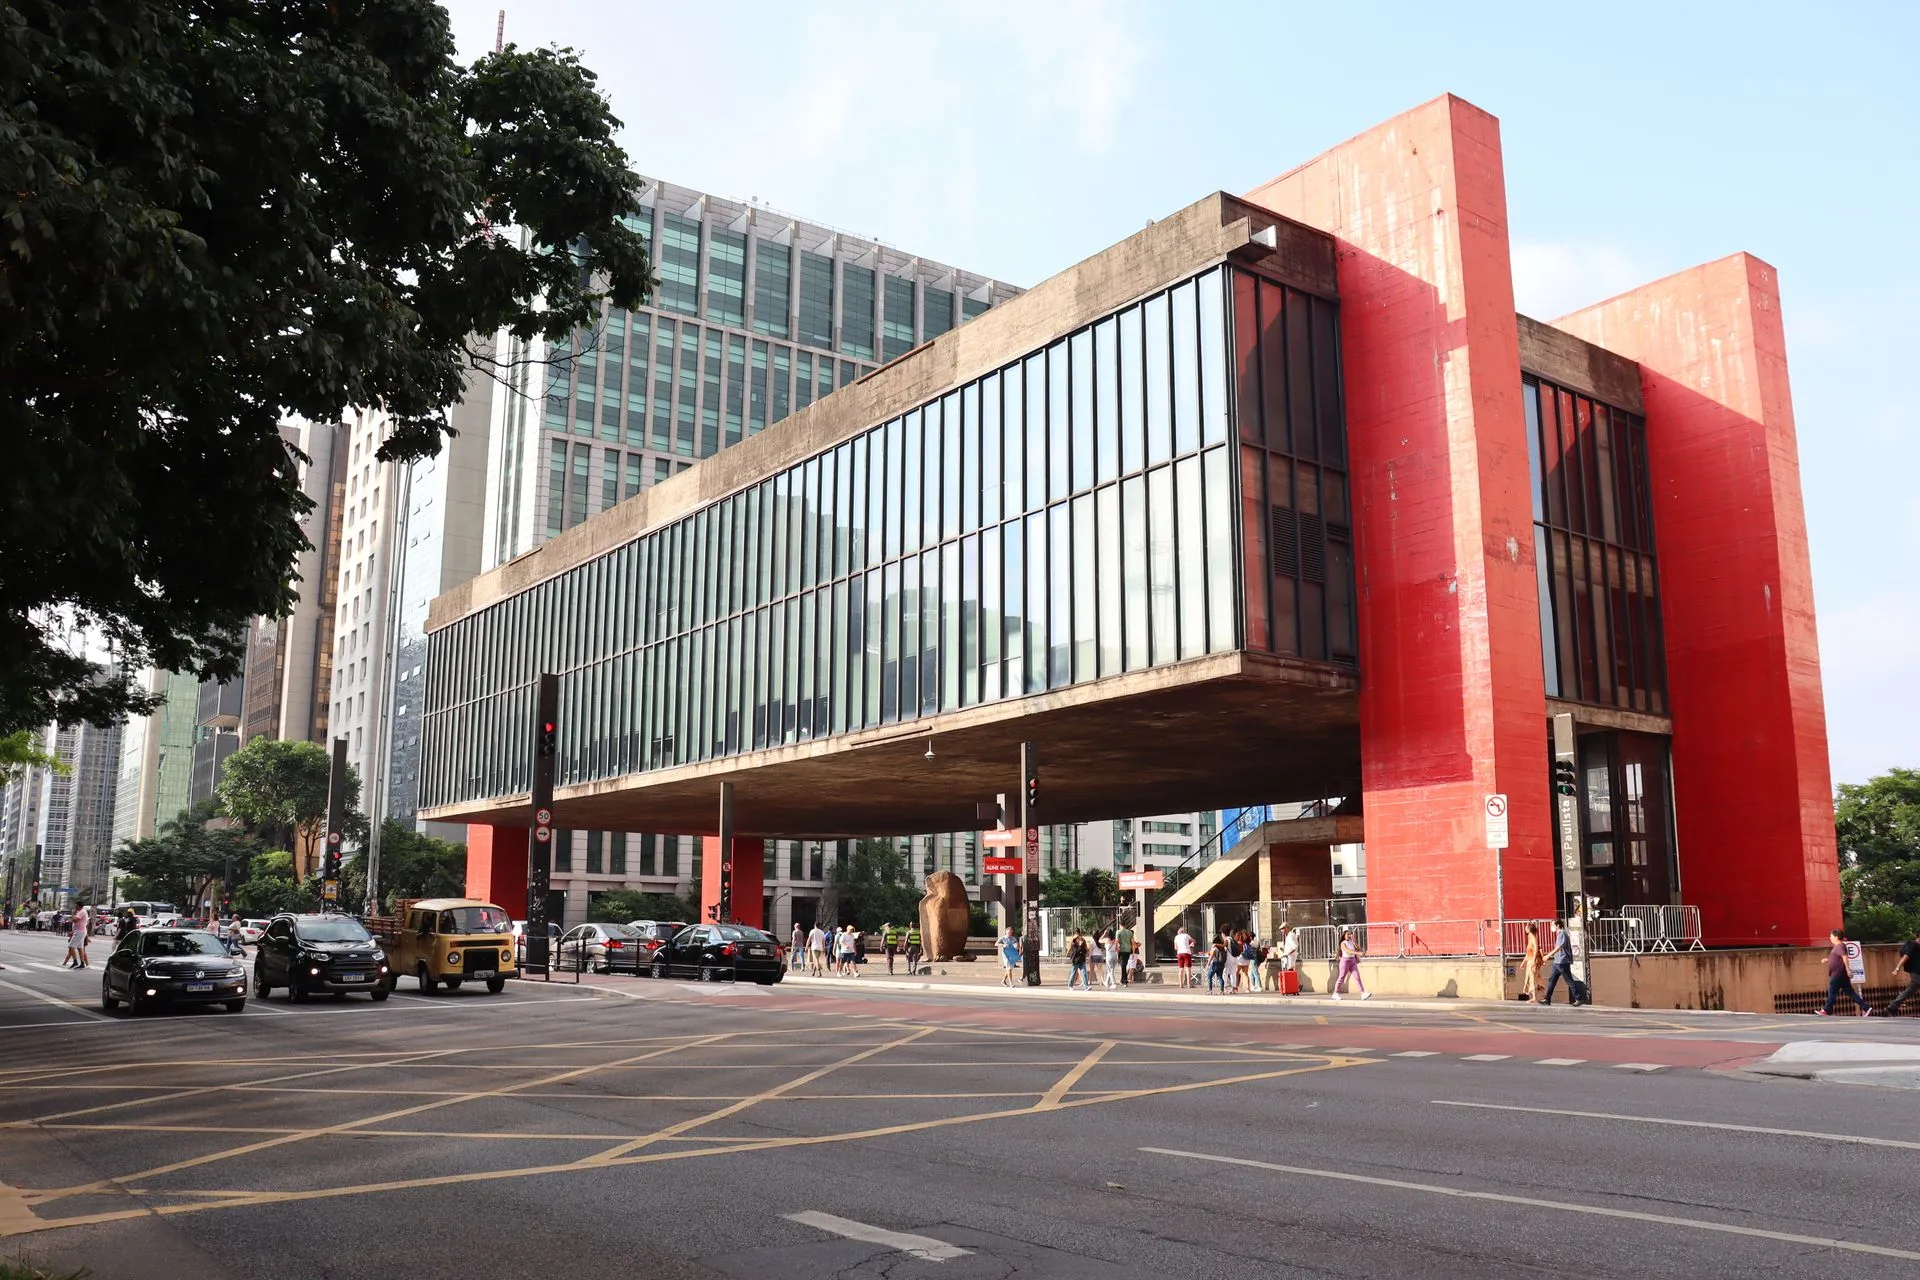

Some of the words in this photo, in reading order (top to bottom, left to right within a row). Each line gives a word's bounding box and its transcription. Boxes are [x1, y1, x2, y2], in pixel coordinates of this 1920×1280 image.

[539, 812, 549, 820] 50
[1562, 800, 1573, 850] Paulista
[1848, 946, 1855, 955] E
